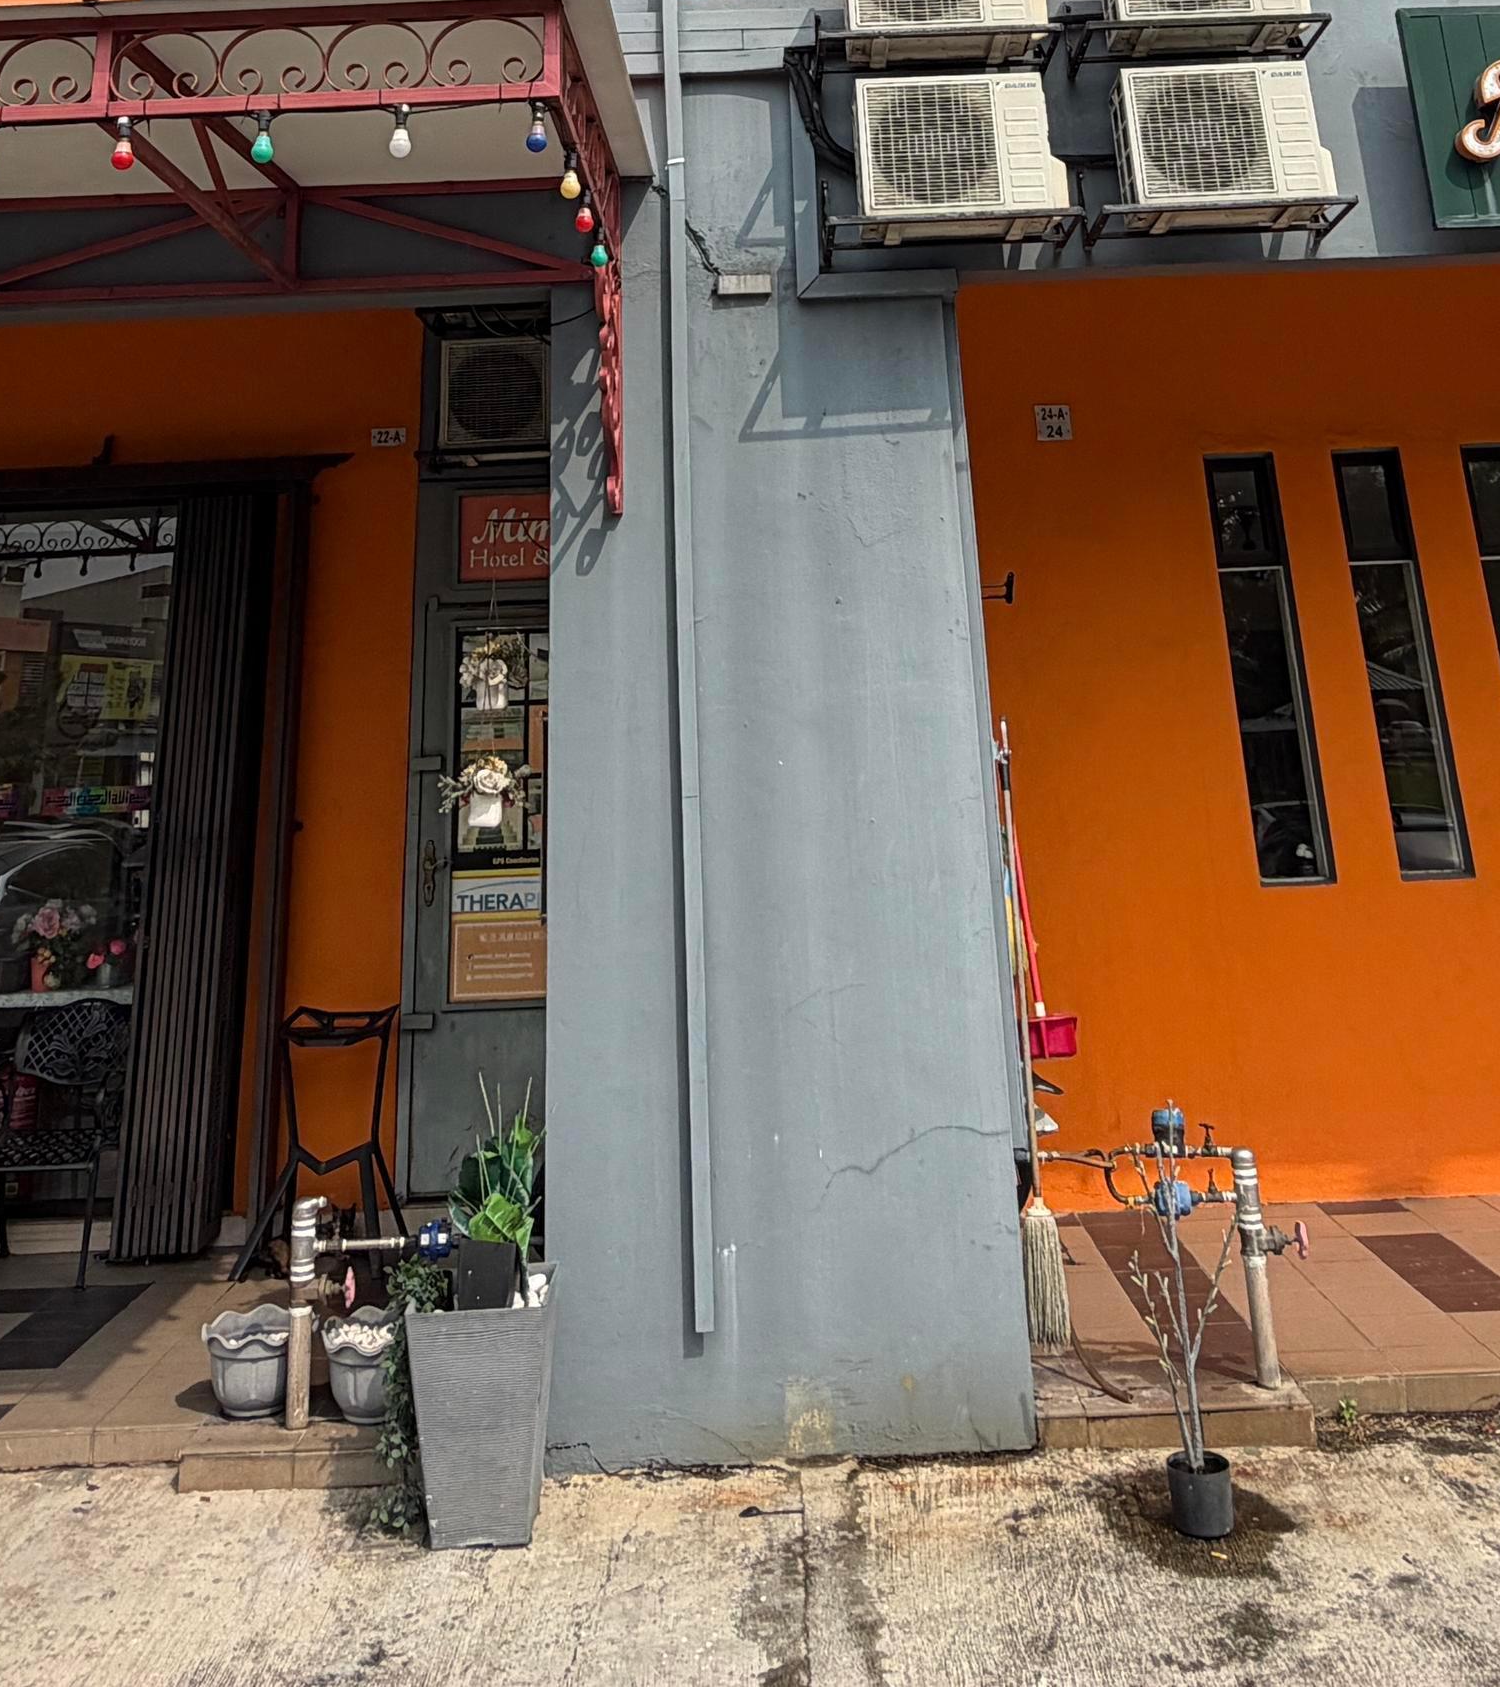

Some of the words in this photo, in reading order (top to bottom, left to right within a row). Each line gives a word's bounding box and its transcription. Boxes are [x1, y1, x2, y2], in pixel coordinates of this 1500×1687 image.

[376, 430, 402, 443] 22-A
[1047, 425, 1063, 438] 24
[469, 547, 525, 569] Hotel
[533, 548, 550, 566] &
